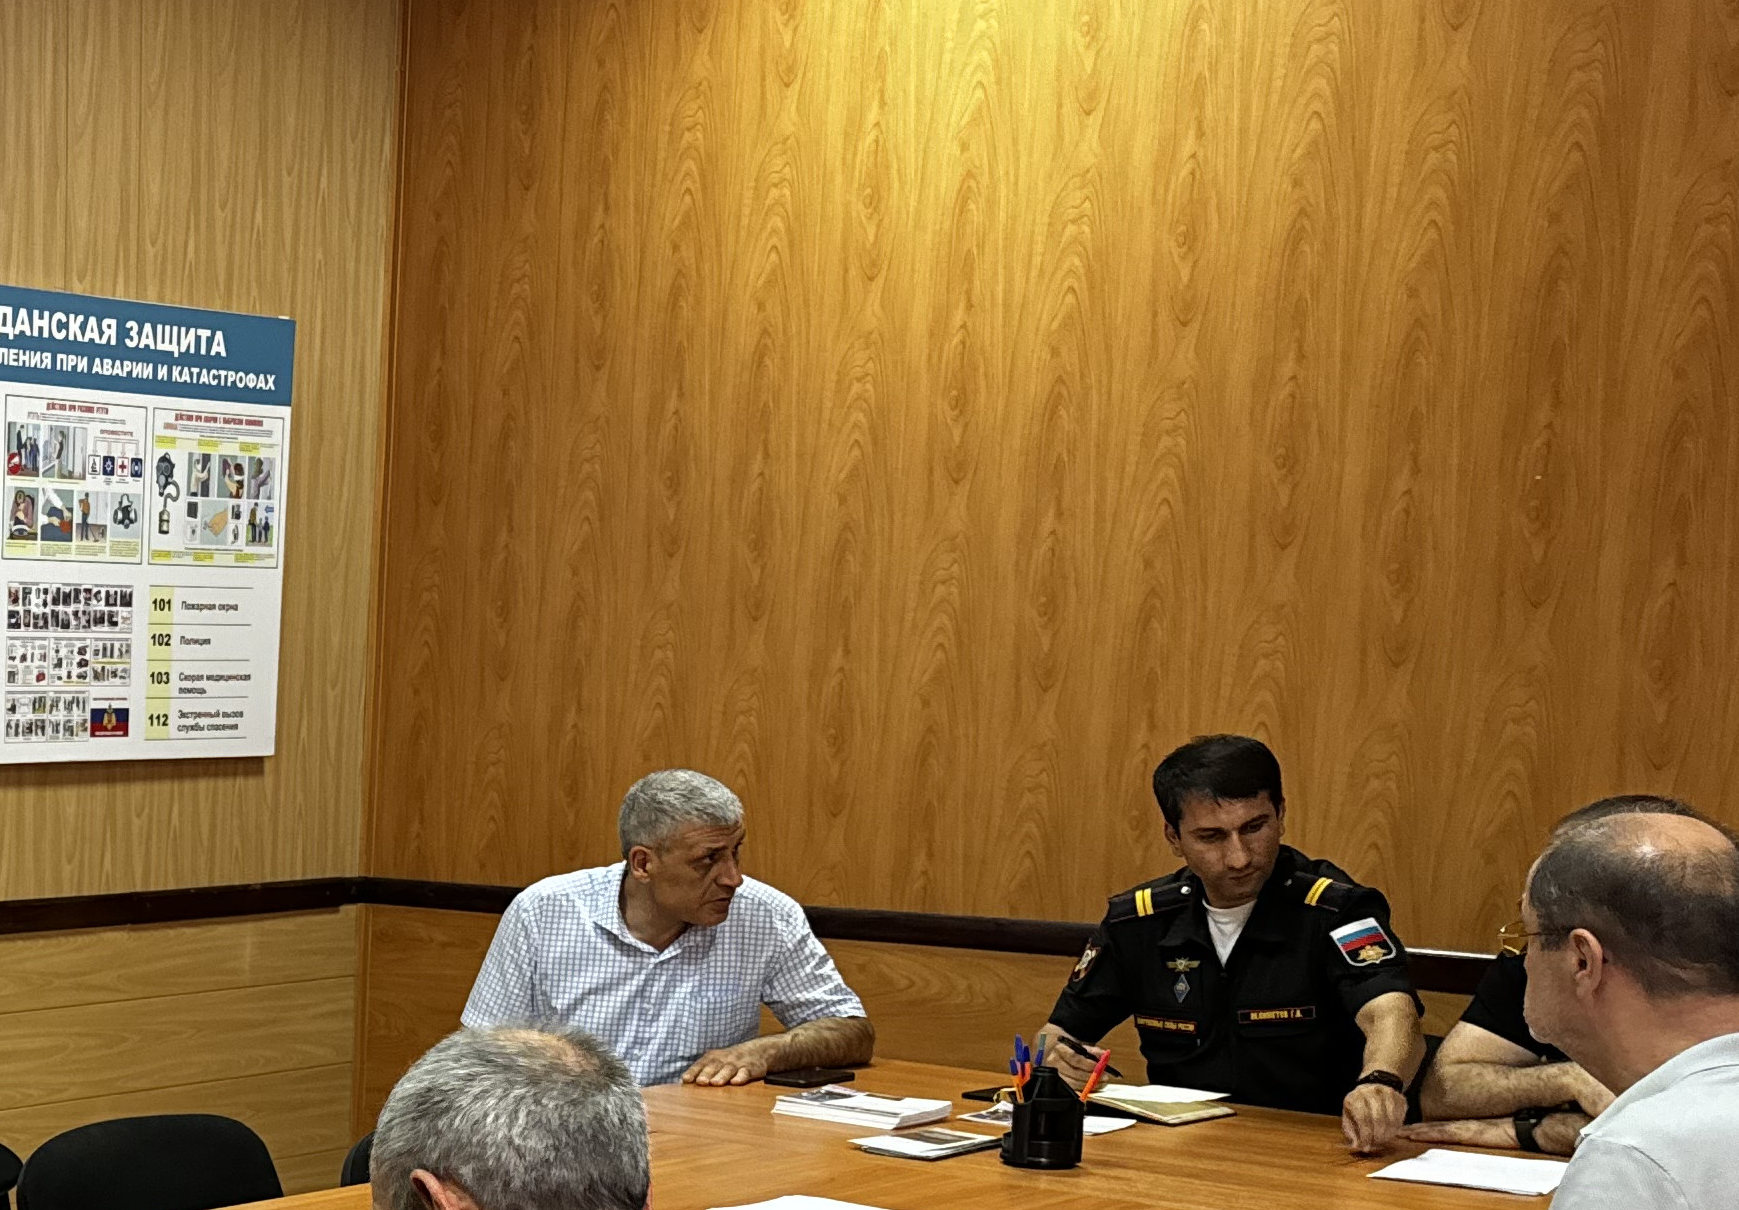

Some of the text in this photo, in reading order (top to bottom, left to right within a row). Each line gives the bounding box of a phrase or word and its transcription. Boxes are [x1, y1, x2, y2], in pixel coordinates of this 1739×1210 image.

[124, 319, 227, 358] ЗАЩИТА
[57, 353, 88, 375] ПРИ
[92, 357, 153, 380] АВАРИИ
[157, 365, 168, 381] И
[172, 366, 276, 391] КАТАСТРОФАХ
[152, 598, 172, 612] 101
[181, 601, 216, 612] Пожарная
[150, 633, 211, 646] 102 Полиция
[149, 672, 170, 684] 103
[178, 672, 204, 683] Скорая
[178, 687, 207, 695] помощь
[148, 714, 169, 727] 112
[177, 709, 220, 721] Экстренный
[177, 723, 205, 734] службы
